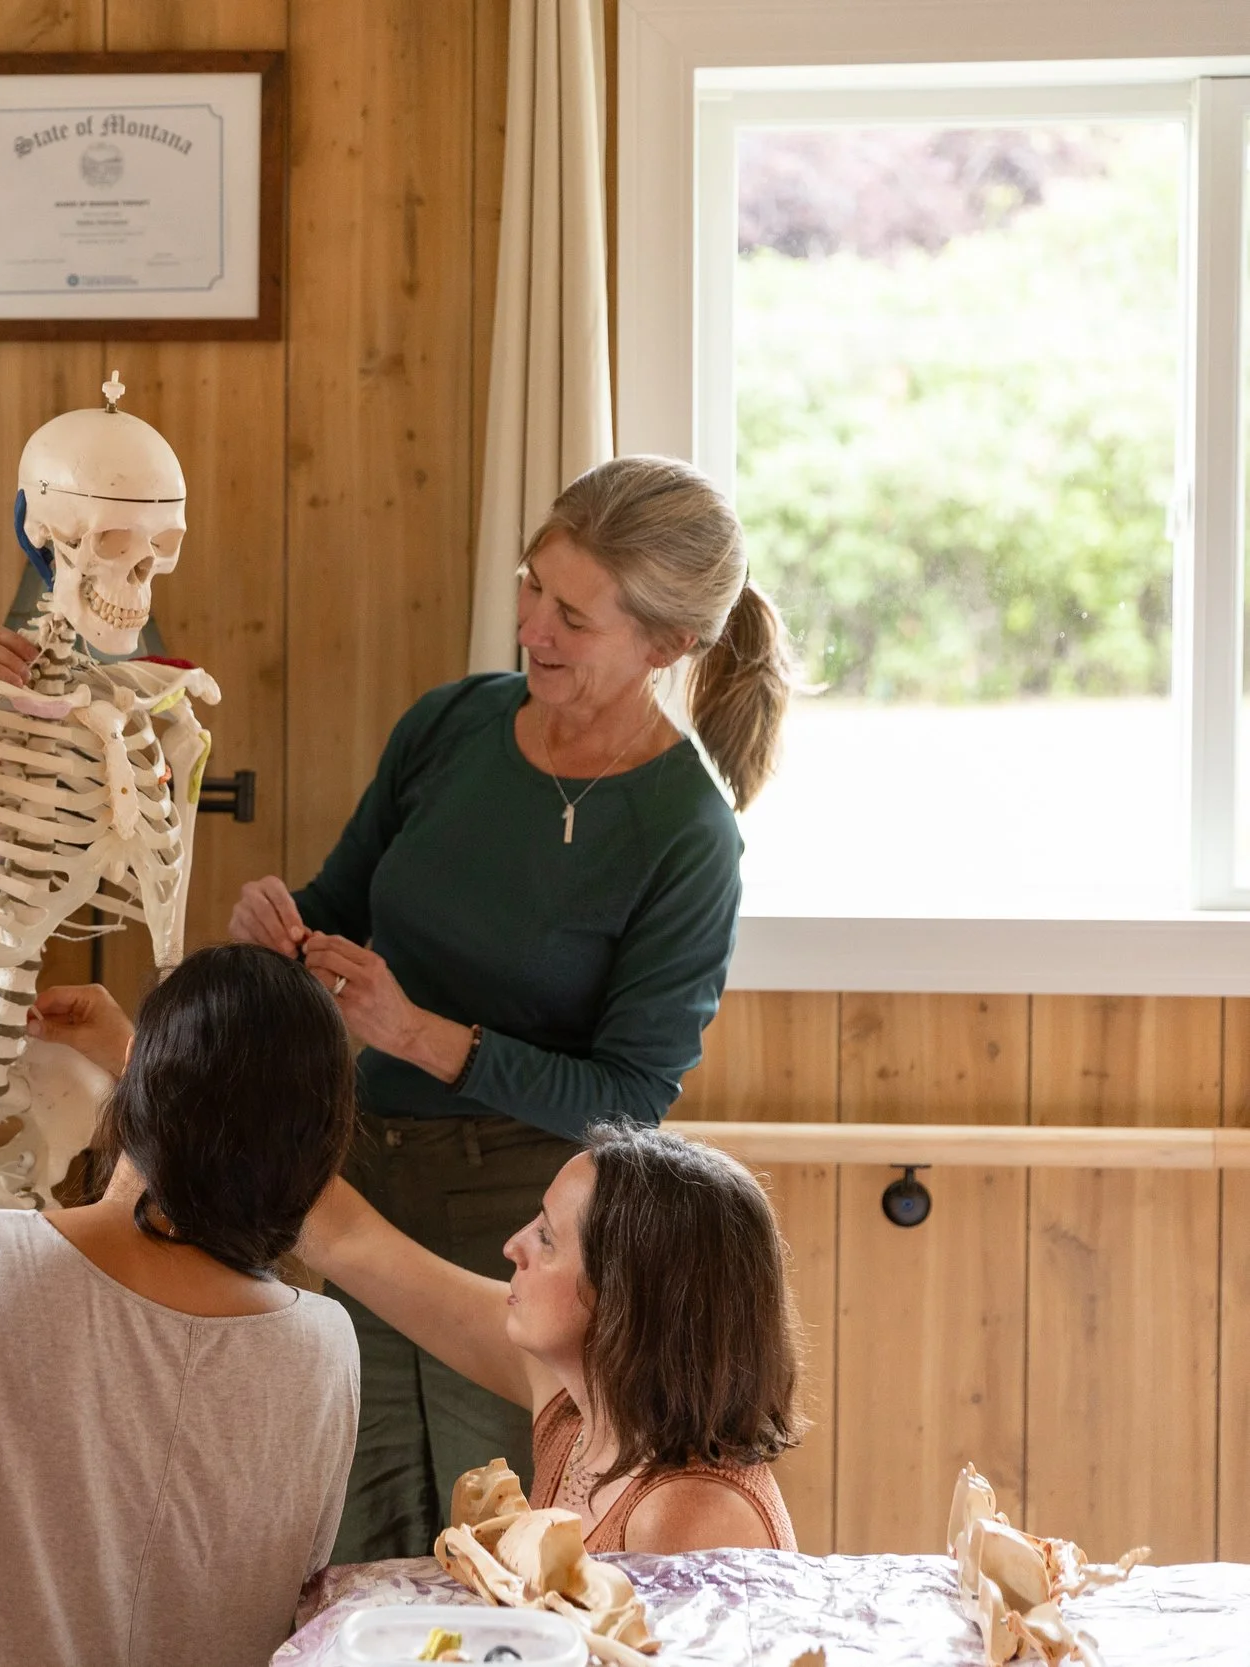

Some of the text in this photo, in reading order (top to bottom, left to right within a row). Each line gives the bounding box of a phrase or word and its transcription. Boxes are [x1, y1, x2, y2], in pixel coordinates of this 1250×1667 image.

[13, 113, 193, 158] State of Montana
